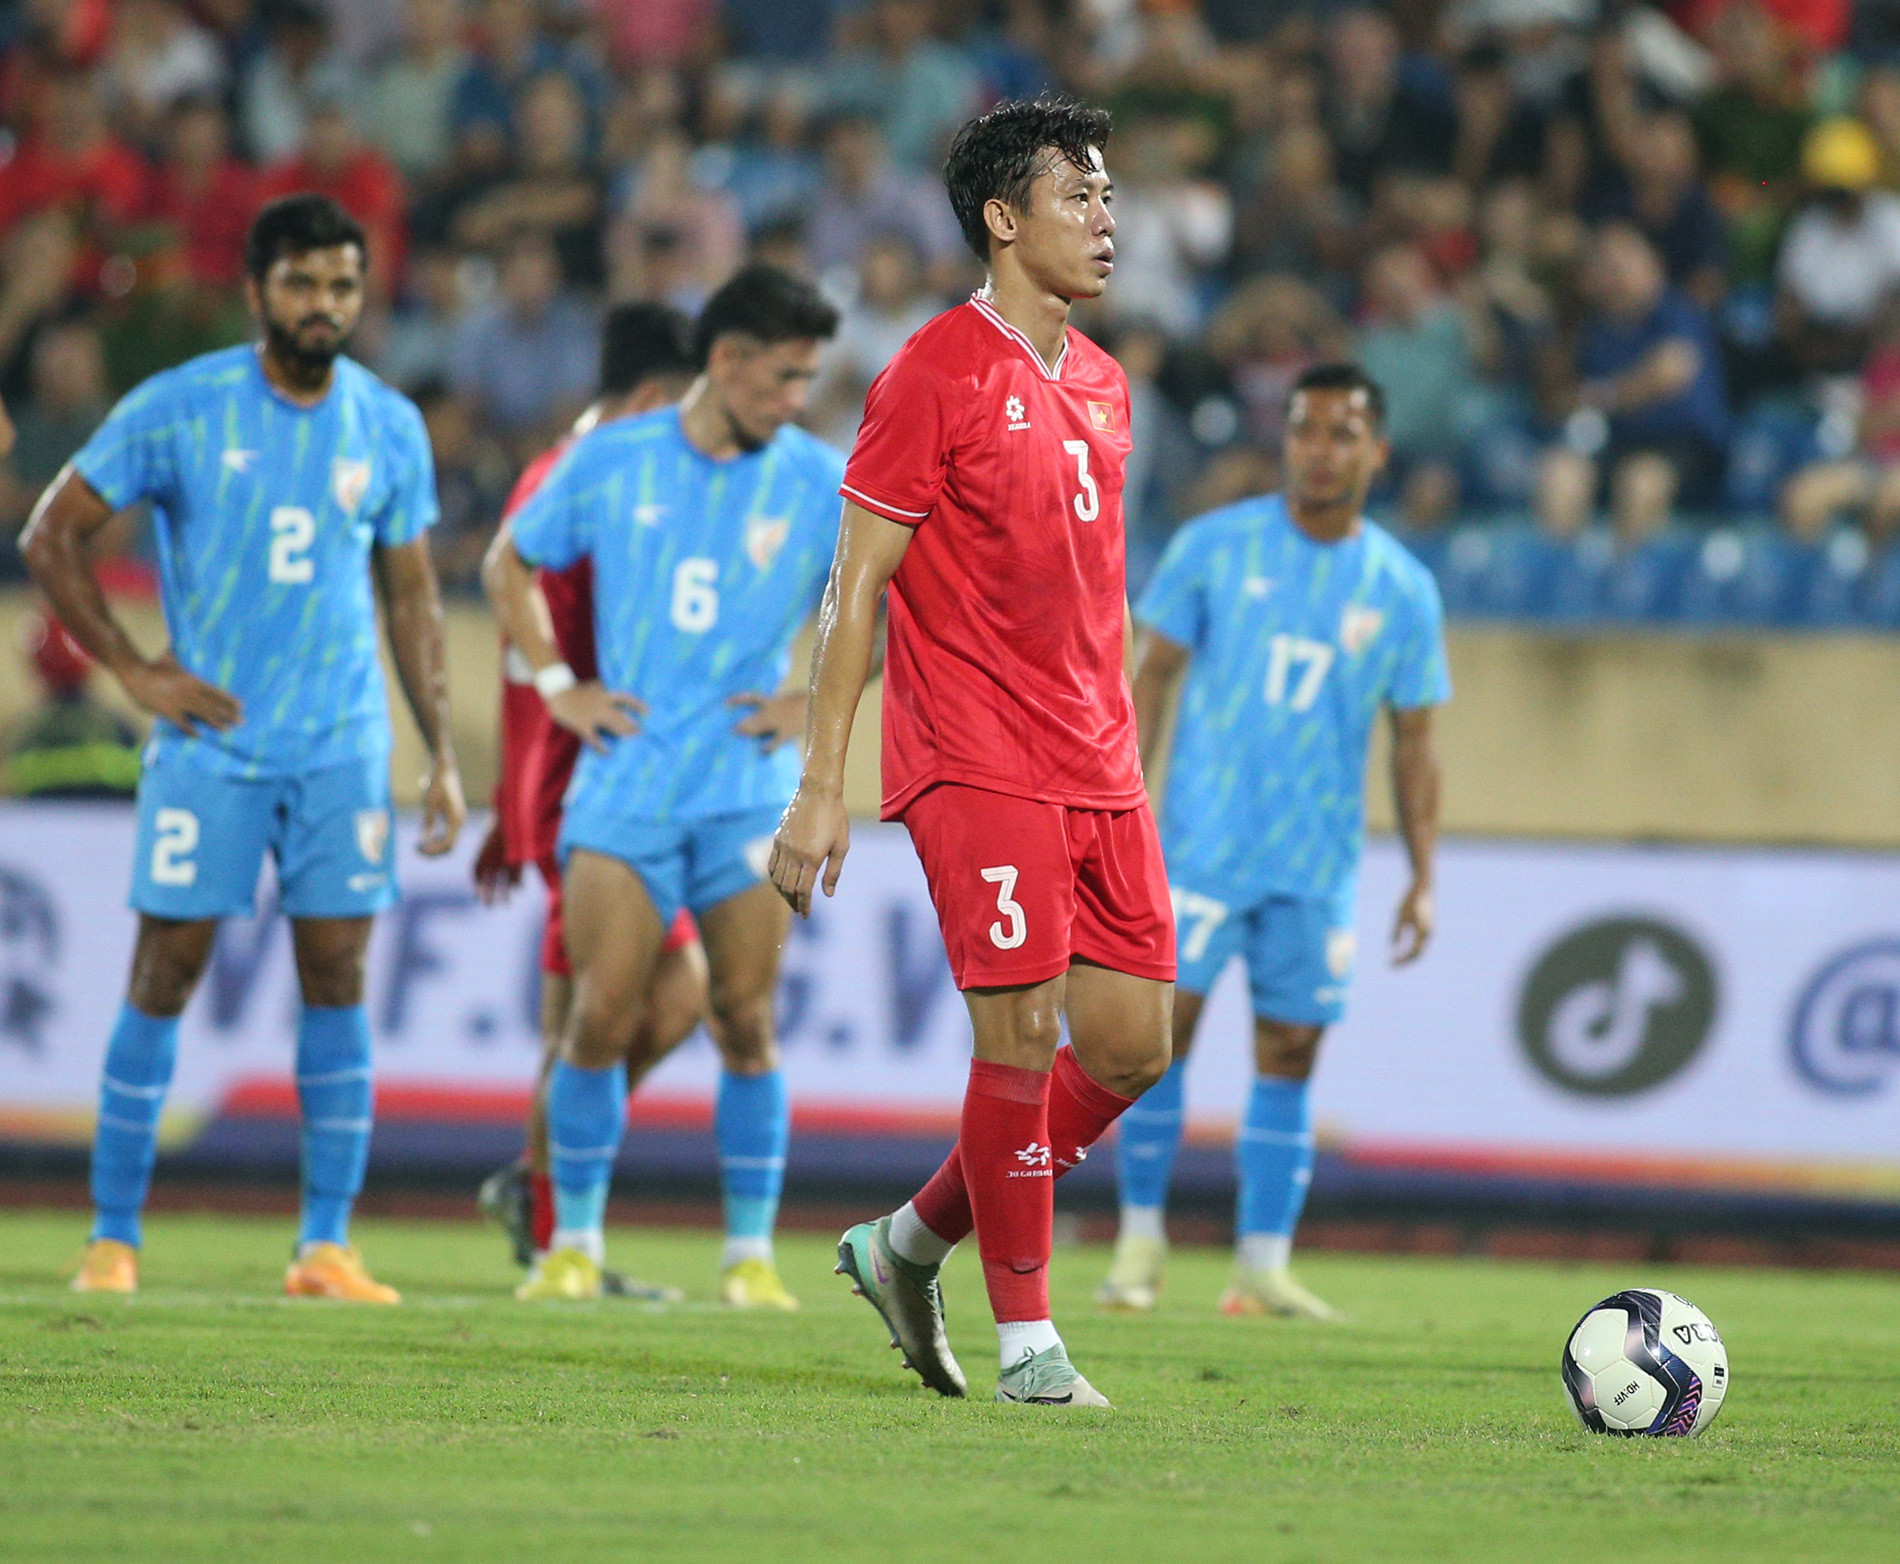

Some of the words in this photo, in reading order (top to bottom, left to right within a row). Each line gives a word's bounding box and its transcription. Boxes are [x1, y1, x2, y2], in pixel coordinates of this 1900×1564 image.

[1062, 440, 1100, 523] 3
[269, 506, 315, 584] 2
[669, 556, 720, 635] 6
[1264, 633, 1334, 712] 17
[151, 807, 200, 887] 2
[980, 865, 1027, 950] 3
